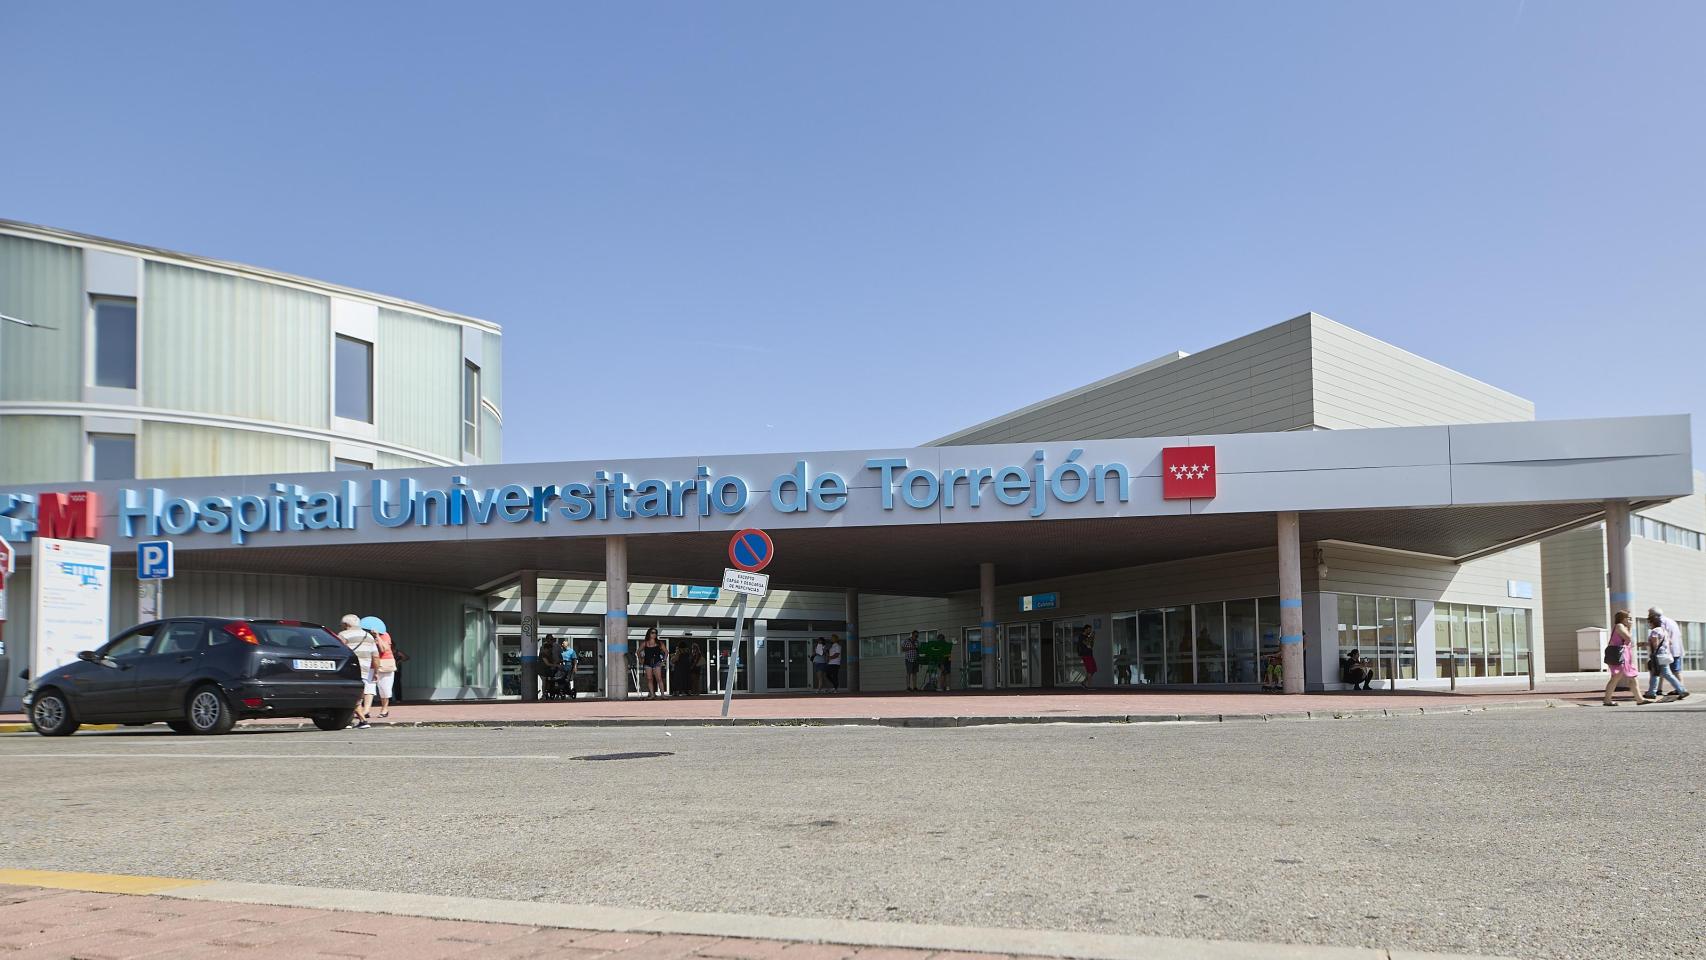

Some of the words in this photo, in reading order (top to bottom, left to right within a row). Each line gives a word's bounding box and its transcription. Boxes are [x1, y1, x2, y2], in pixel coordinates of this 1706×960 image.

[38, 491, 96, 538] M
[118, 479, 357, 544] Hospital
[370, 465, 751, 528] Universitario
[769, 460, 848, 513] de
[866, 448, 1130, 517] Torrejón
[143, 546, 164, 575] P
